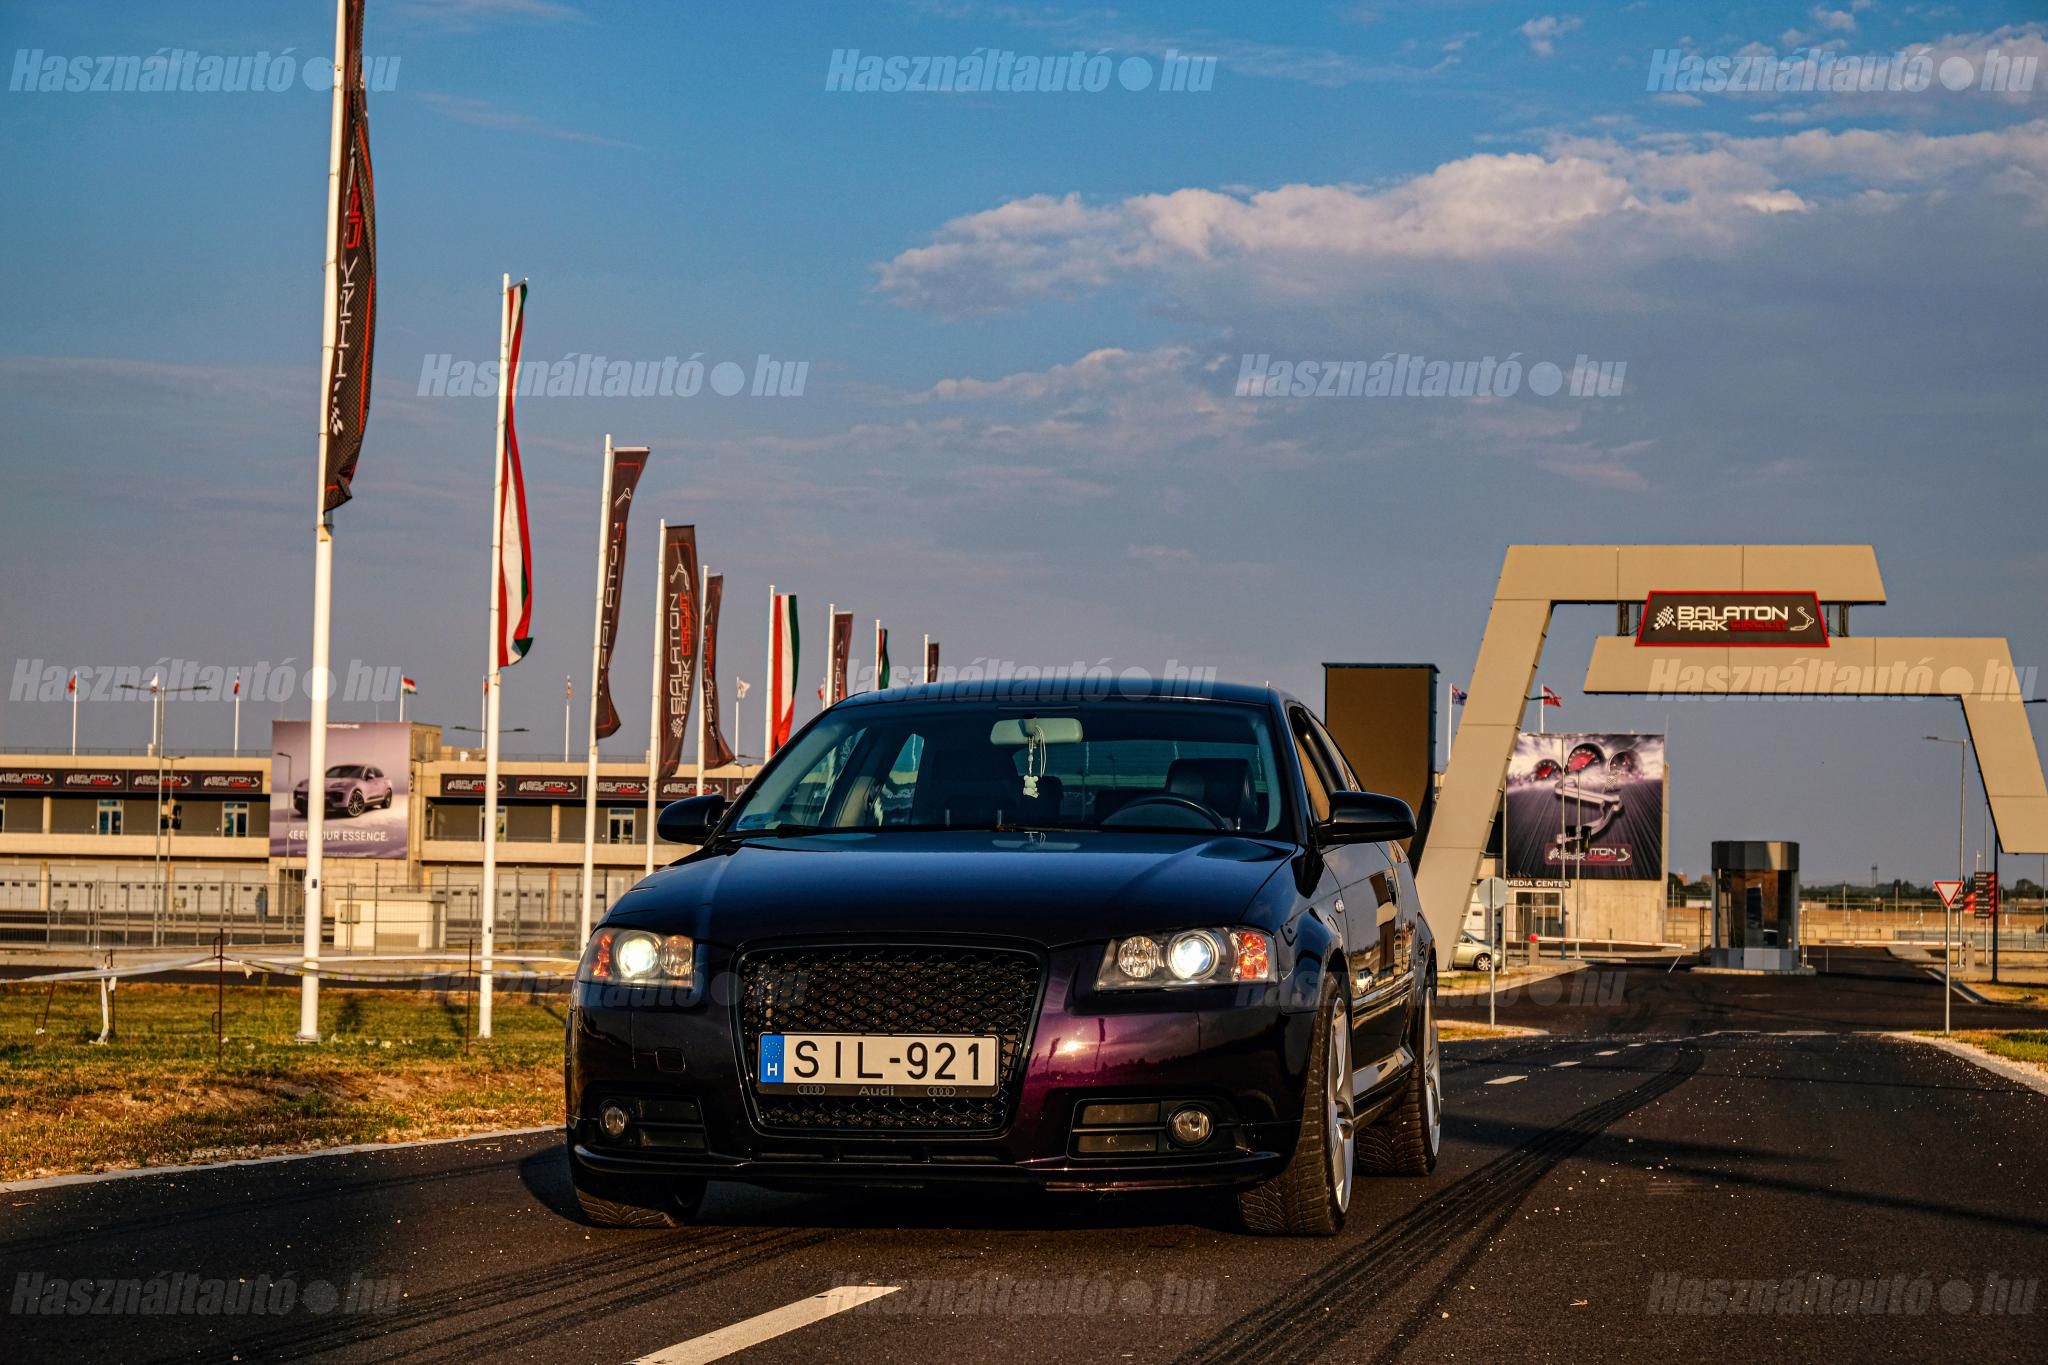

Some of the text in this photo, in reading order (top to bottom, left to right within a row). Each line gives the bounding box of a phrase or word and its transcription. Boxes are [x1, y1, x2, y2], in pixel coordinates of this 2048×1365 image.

[1678, 606, 1788, 621] BALATON
[1678, 620, 1728, 631] PARK
[669, 593, 683, 715] BALATON
[767, 1040, 980, 1081] H SIL-921
[859, 1086, 895, 1096] Audi
